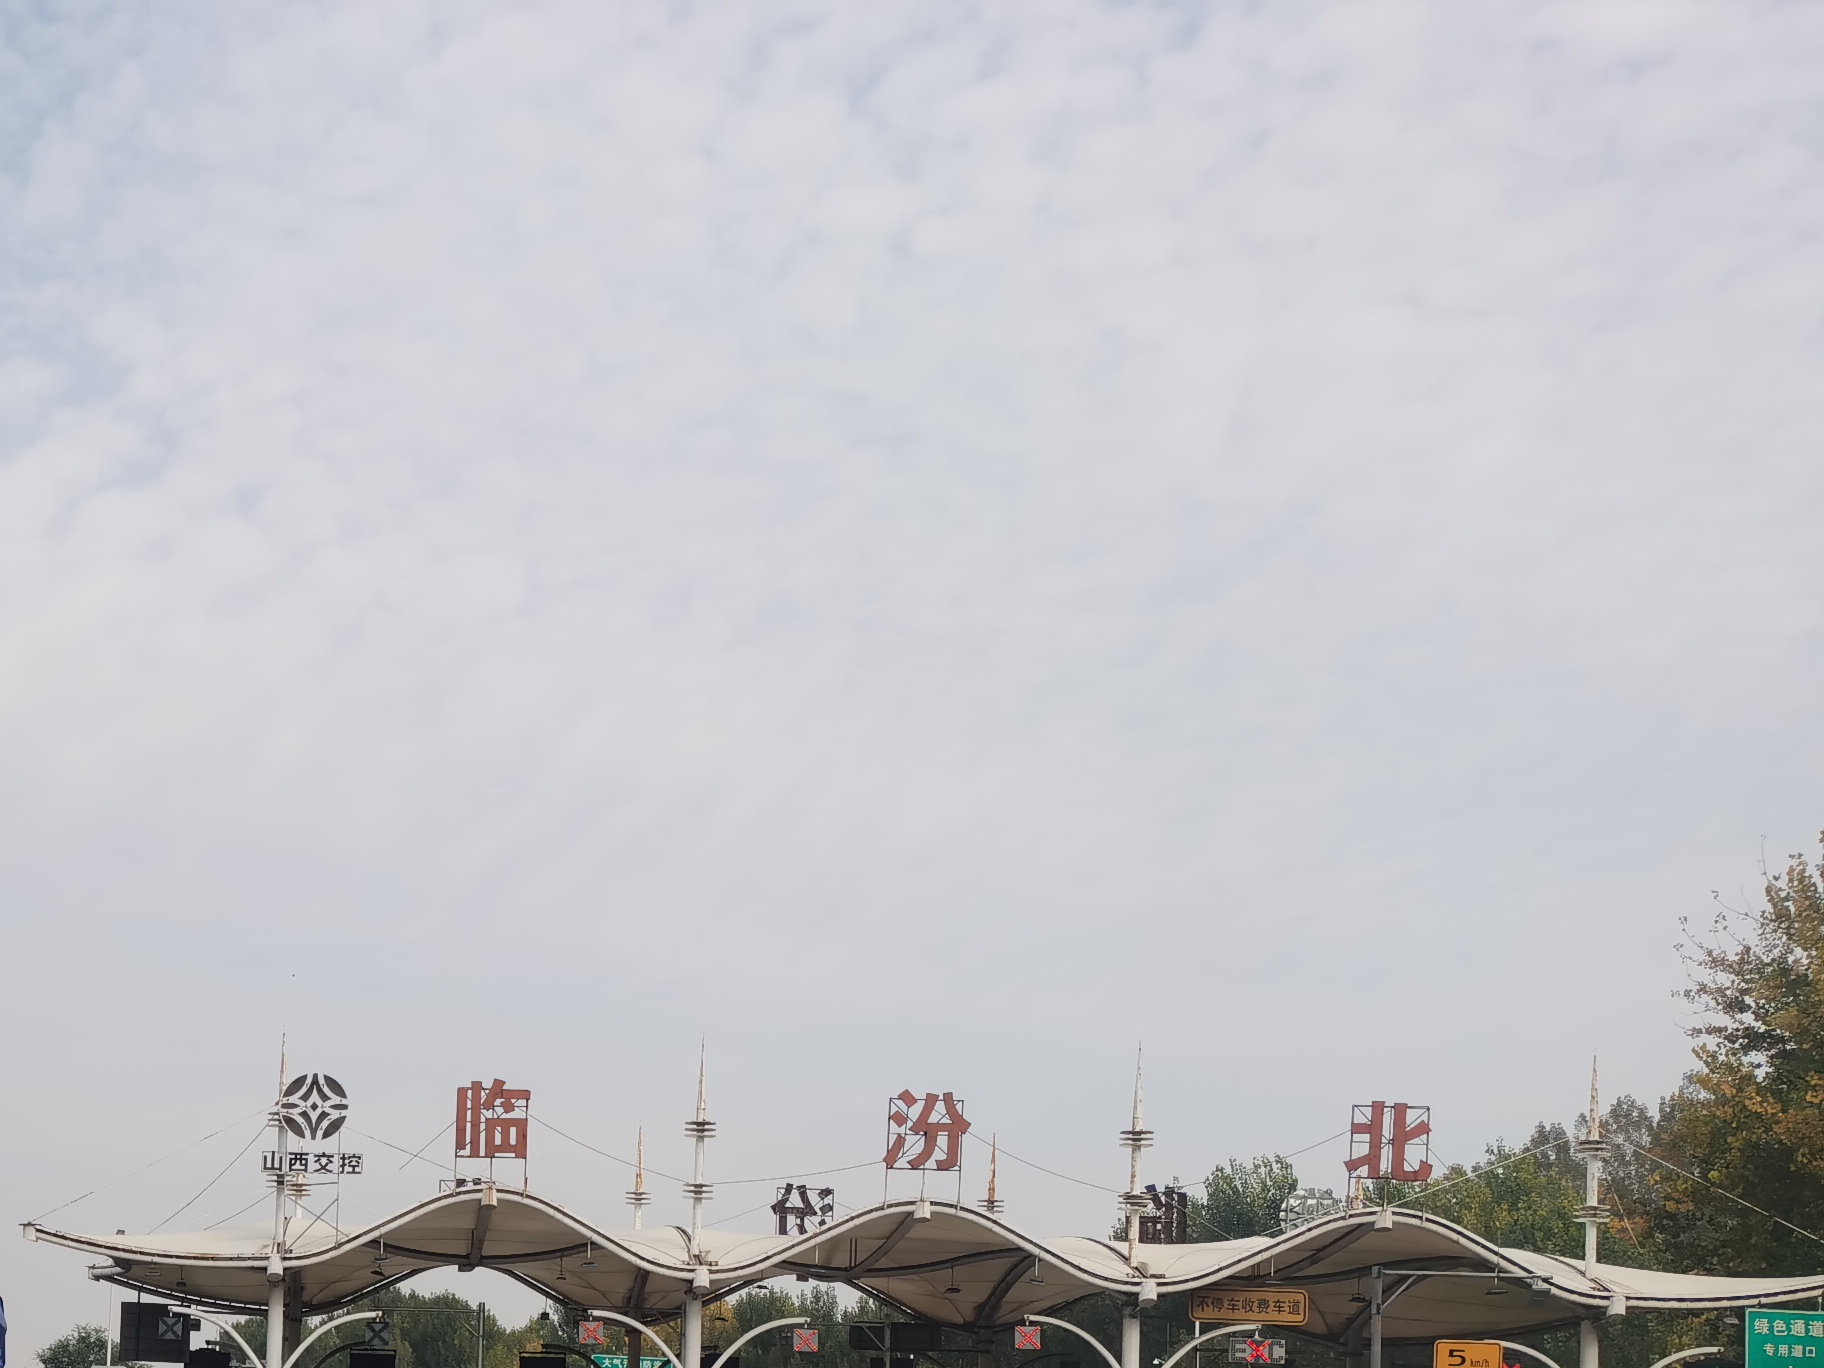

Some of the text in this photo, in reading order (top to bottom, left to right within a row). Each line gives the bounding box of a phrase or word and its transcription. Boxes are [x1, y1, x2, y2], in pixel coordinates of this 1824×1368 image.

[455, 1078, 1433, 1182] 临 汾 北
[263, 1151, 362, 1174] 山西交控
[1196, 1296, 1302, 1315] 不停车收费车道
[1753, 1318, 1824, 1338] 绿色通道
[1448, 1349, 1490, 1368] 5 km/h
[1762, 1343, 1817, 1358] 专用道口
